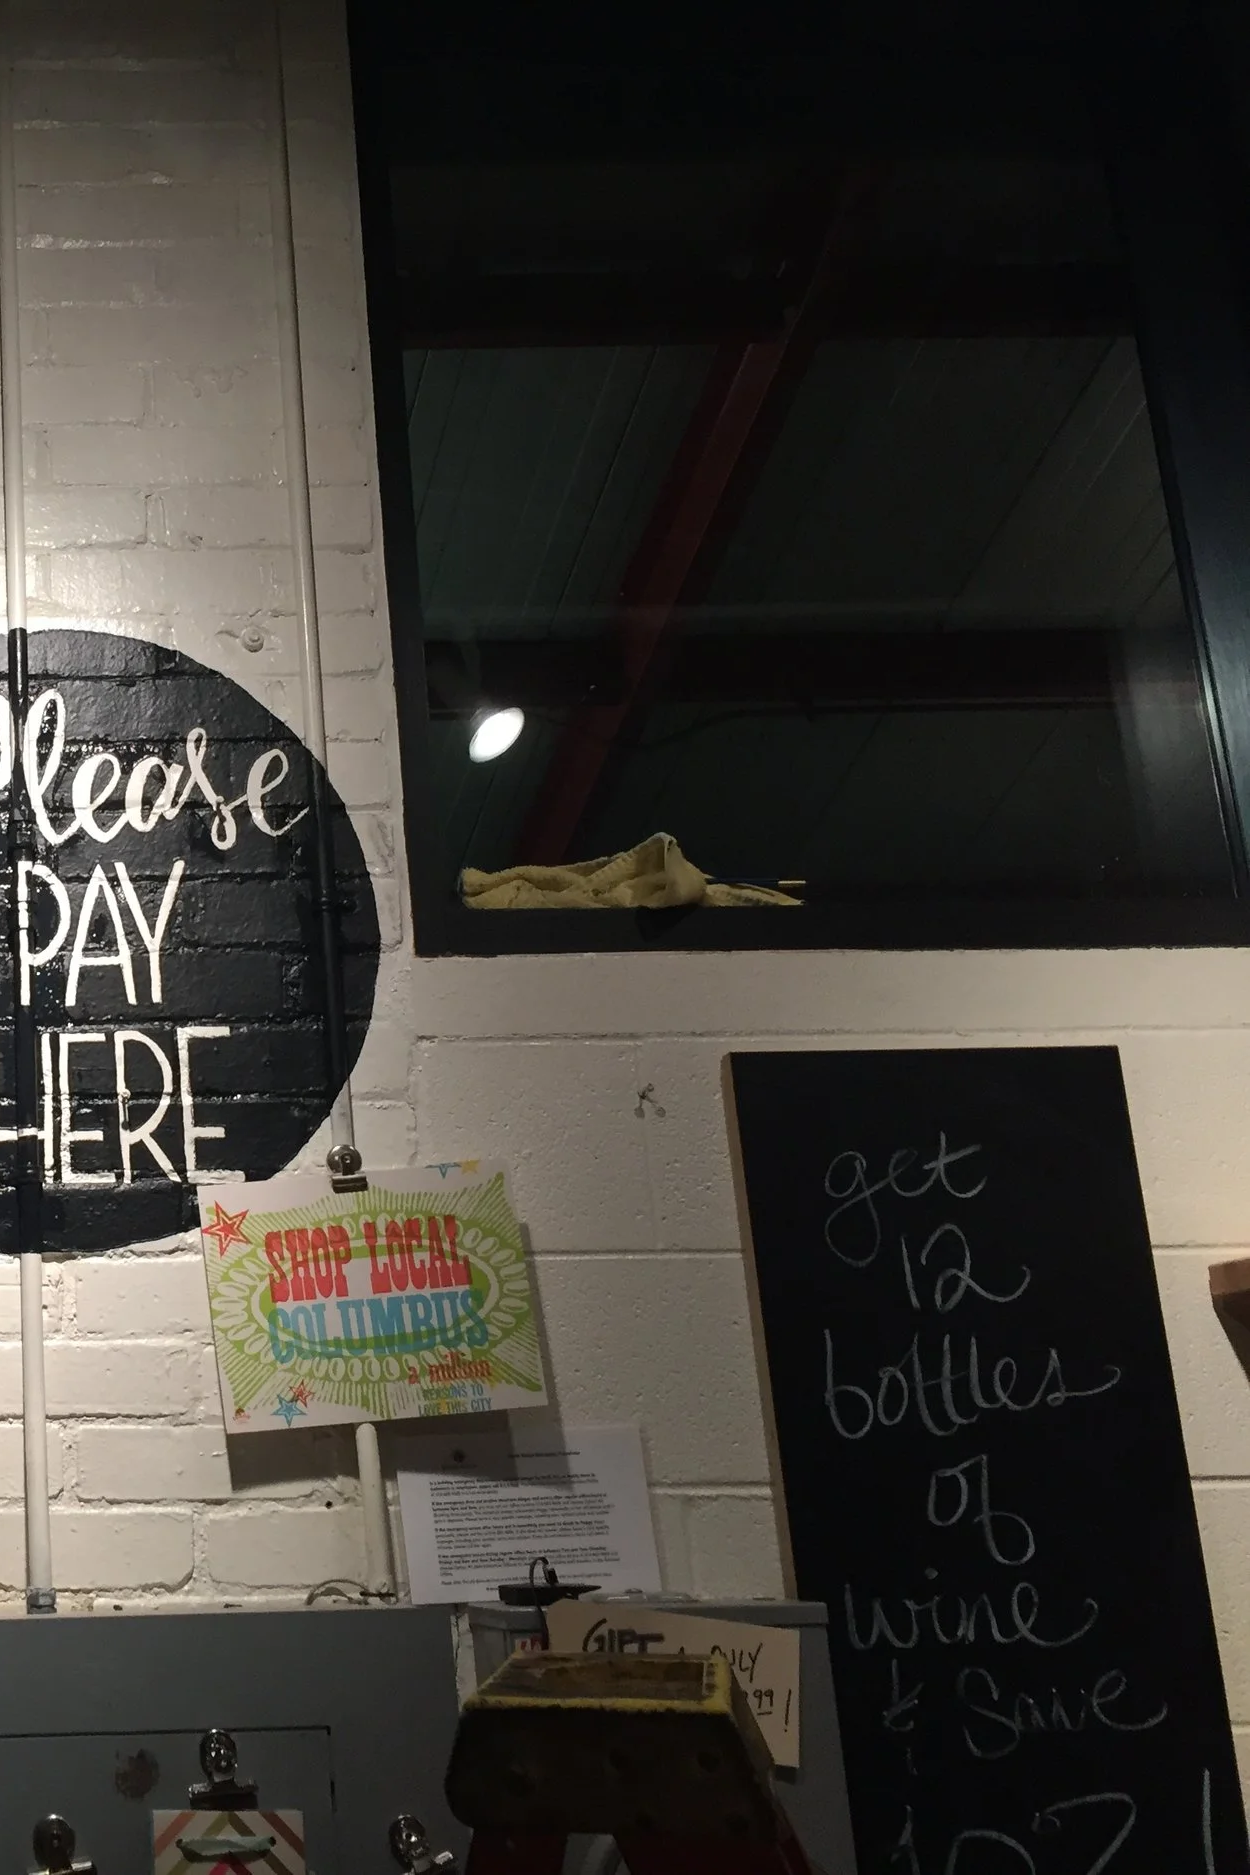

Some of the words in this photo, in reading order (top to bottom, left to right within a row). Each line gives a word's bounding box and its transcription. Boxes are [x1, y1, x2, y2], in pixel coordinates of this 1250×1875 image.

[17, 860, 185, 1006] PAY
[824, 1130, 988, 1267] get
[264, 1224, 352, 1304] SHOP
[363, 1214, 474, 1295] LOCAL
[901, 1223, 1032, 1313] 12
[267, 1288, 489, 1364] COLUMBUS
[408, 1366, 419, 1385] a
[428, 1351, 491, 1383] million
[418, 1400, 441, 1417] LOVE
[446, 1399, 468, 1414] THIS
[470, 1396, 492, 1411] CITY
[422, 1383, 468, 1401] REASONS
[470, 1383, 484, 1396] TO
[824, 1329, 1122, 1440] bottles
[926, 1454, 1036, 1567] of
[845, 1567, 1100, 1651] wine
[955, 1667, 1169, 1760] Save
